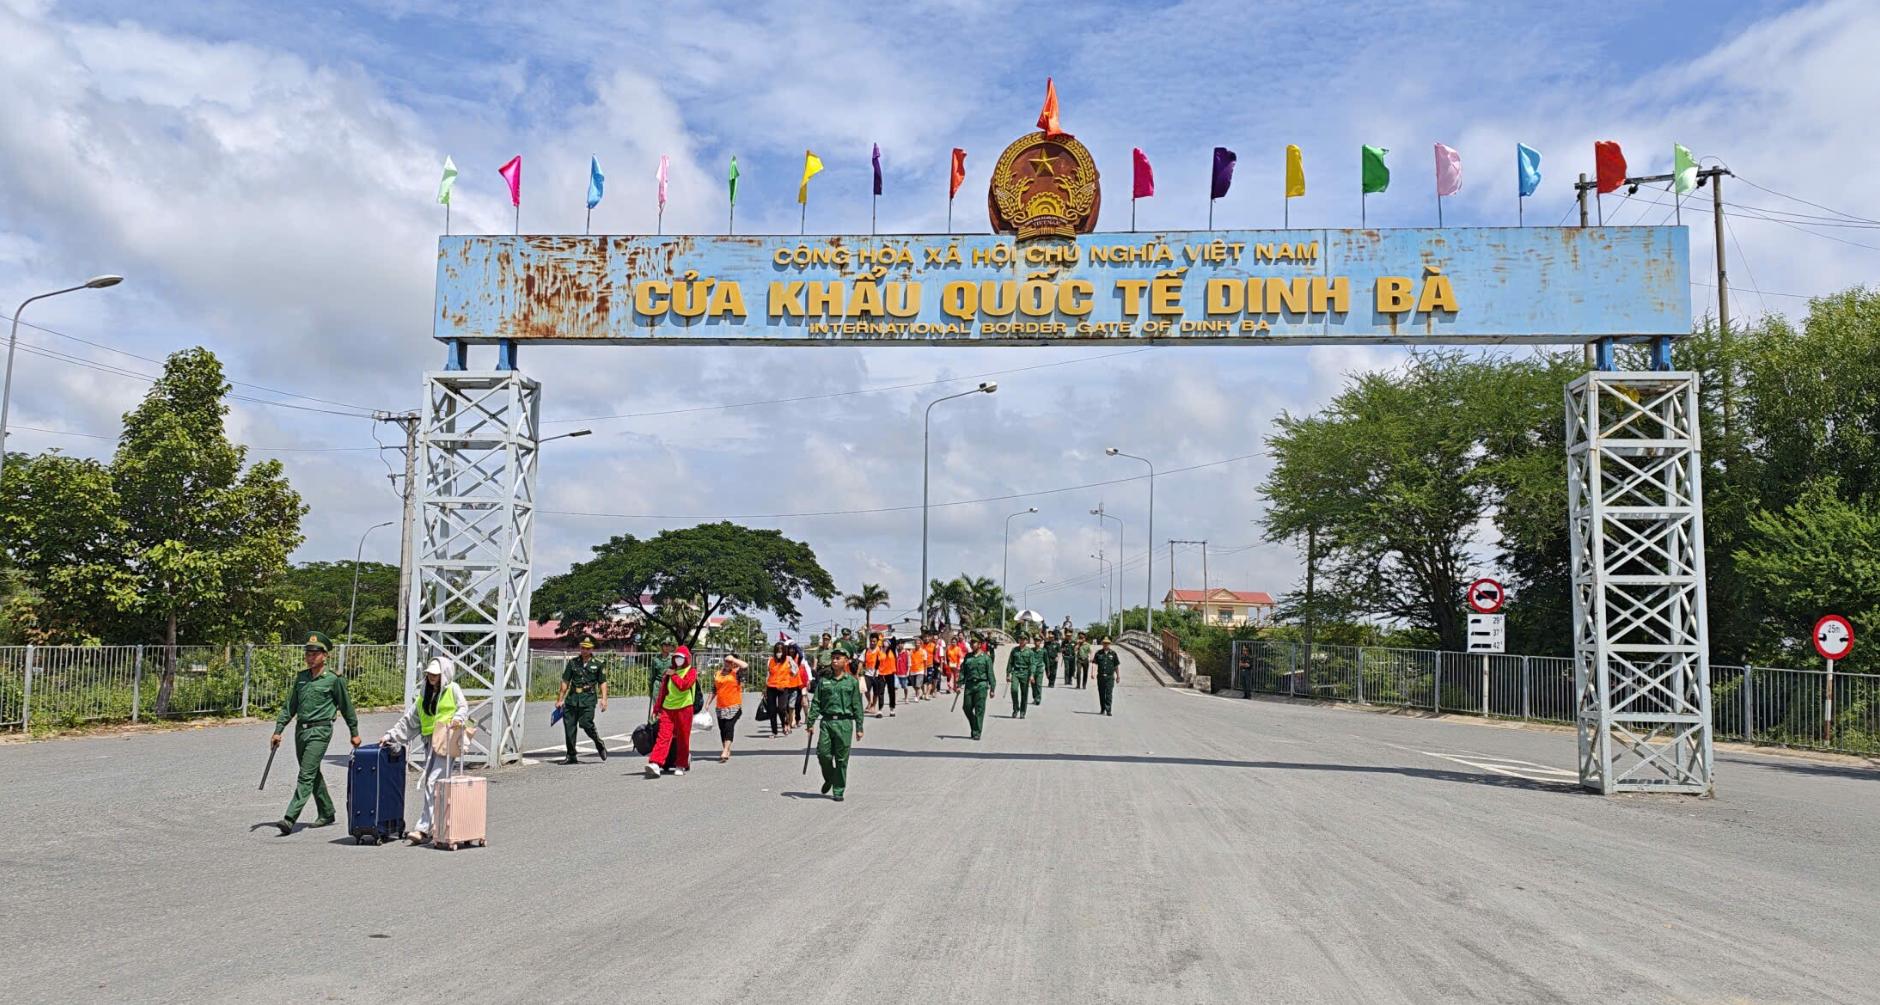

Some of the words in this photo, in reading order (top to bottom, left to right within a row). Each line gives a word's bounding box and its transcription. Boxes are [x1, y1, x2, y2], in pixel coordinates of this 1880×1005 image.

[774, 244, 849, 268] CỘNG
[925, 243, 962, 264] XÃ
[972, 243, 1016, 266] HỘI
[1026, 240, 1079, 262] CHỦ
[1091, 239, 1174, 262] NGHĨA
[1184, 239, 1245, 262] VIỆT
[1256, 241, 1318, 260] NAM
[635, 269, 747, 317] CỬA
[768, 266, 921, 317] KHẨU
[942, 269, 1094, 320] QUỐC
[1116, 267, 1188, 315] TẾ
[1207, 277, 1349, 314] DINH
[1376, 265, 1459, 313] BÀ
[809, 322, 970, 334] INTERNATIONAL
[981, 321, 1066, 334] BORDER
[1077, 321, 1131, 333] GATE
[1142, 321, 1172, 332] OF
[1181, 320, 1231, 332] DINH
[1241, 319, 1270, 331] BA
